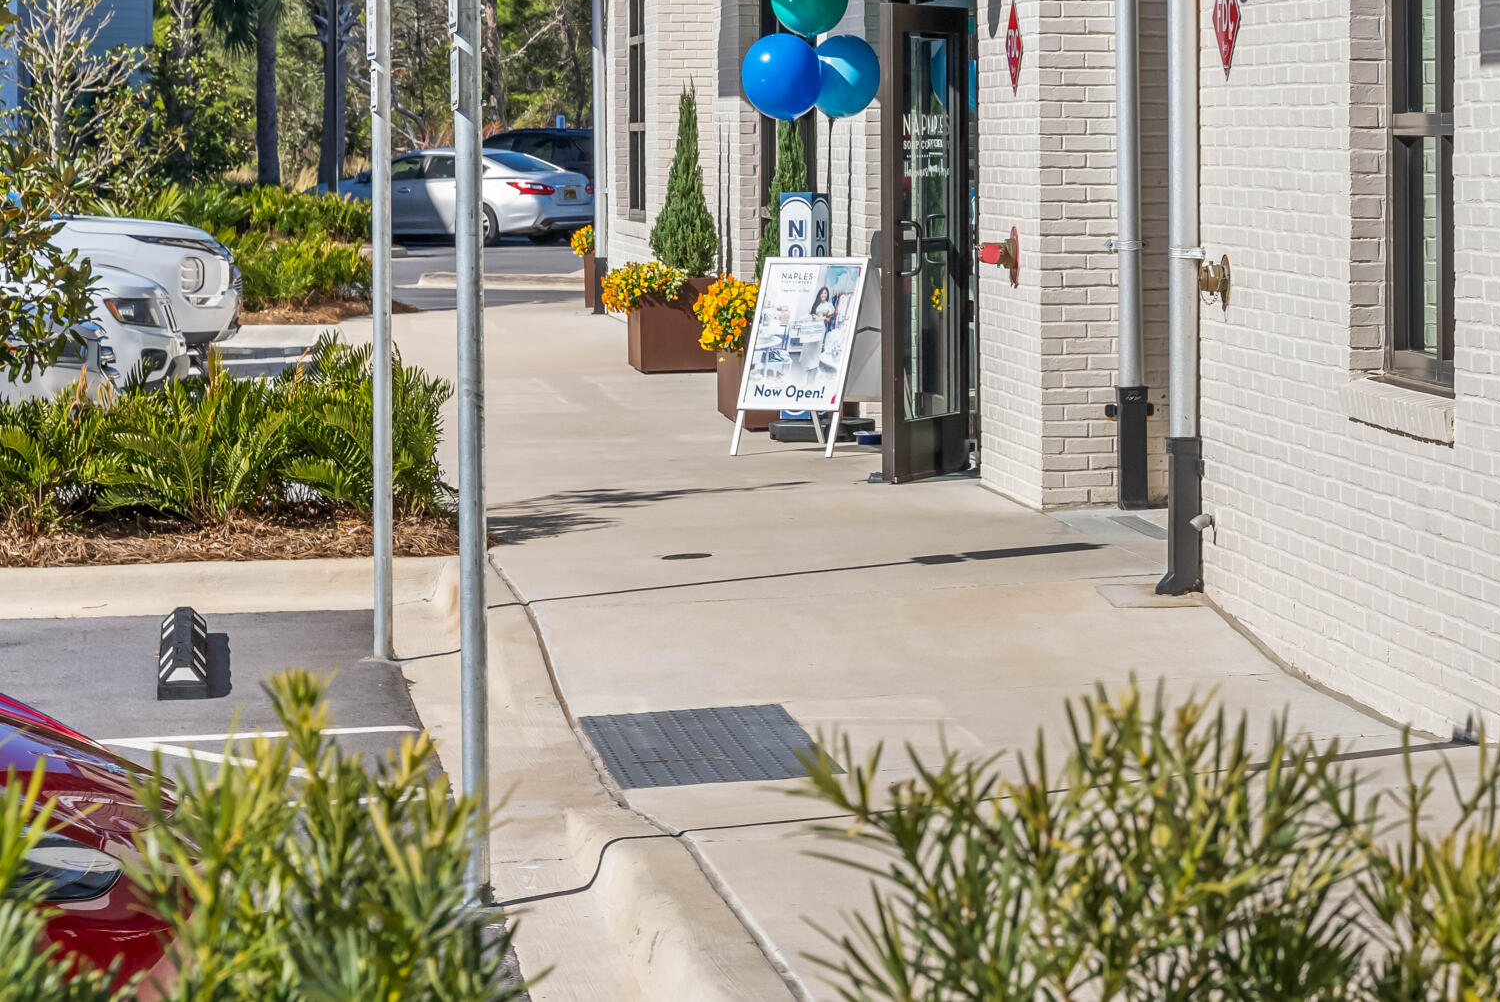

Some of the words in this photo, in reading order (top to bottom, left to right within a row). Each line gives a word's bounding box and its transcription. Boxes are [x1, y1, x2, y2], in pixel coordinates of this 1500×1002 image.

[788, 219, 804, 257] NO
[781, 272, 813, 280] NAPLES
[754, 384, 782, 398] Now
[785, 385, 826, 402] Open!
